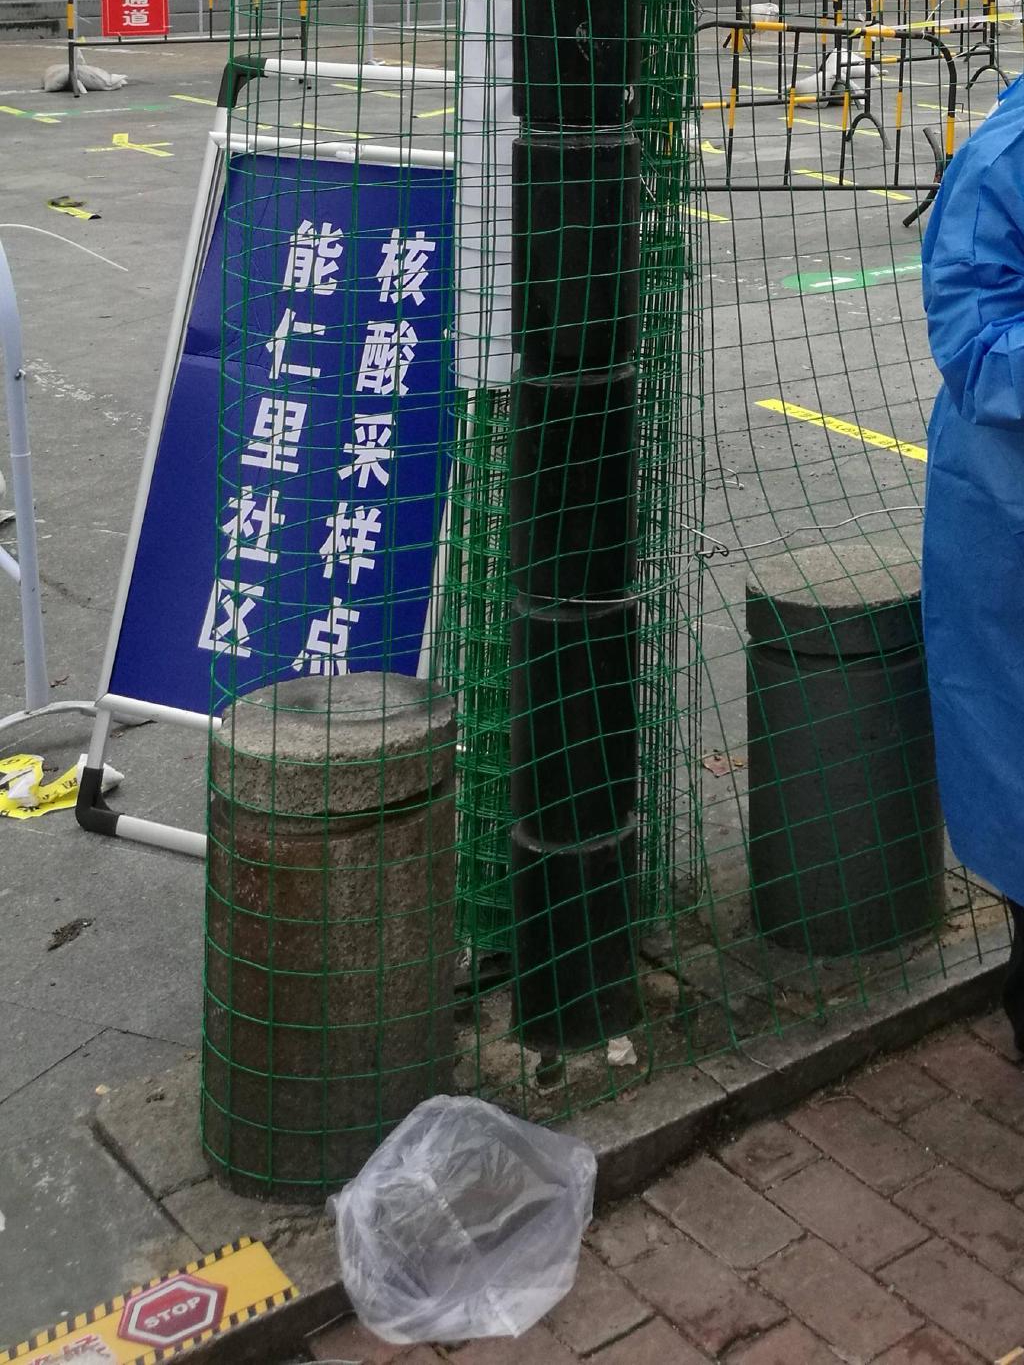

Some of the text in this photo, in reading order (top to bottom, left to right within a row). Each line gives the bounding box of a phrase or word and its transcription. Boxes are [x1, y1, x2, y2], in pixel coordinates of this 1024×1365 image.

[197, 218, 344, 659] 能仁里社区
[291, 227, 436, 677] 核酸采样点
[143, 1295, 201, 1329] STOP
